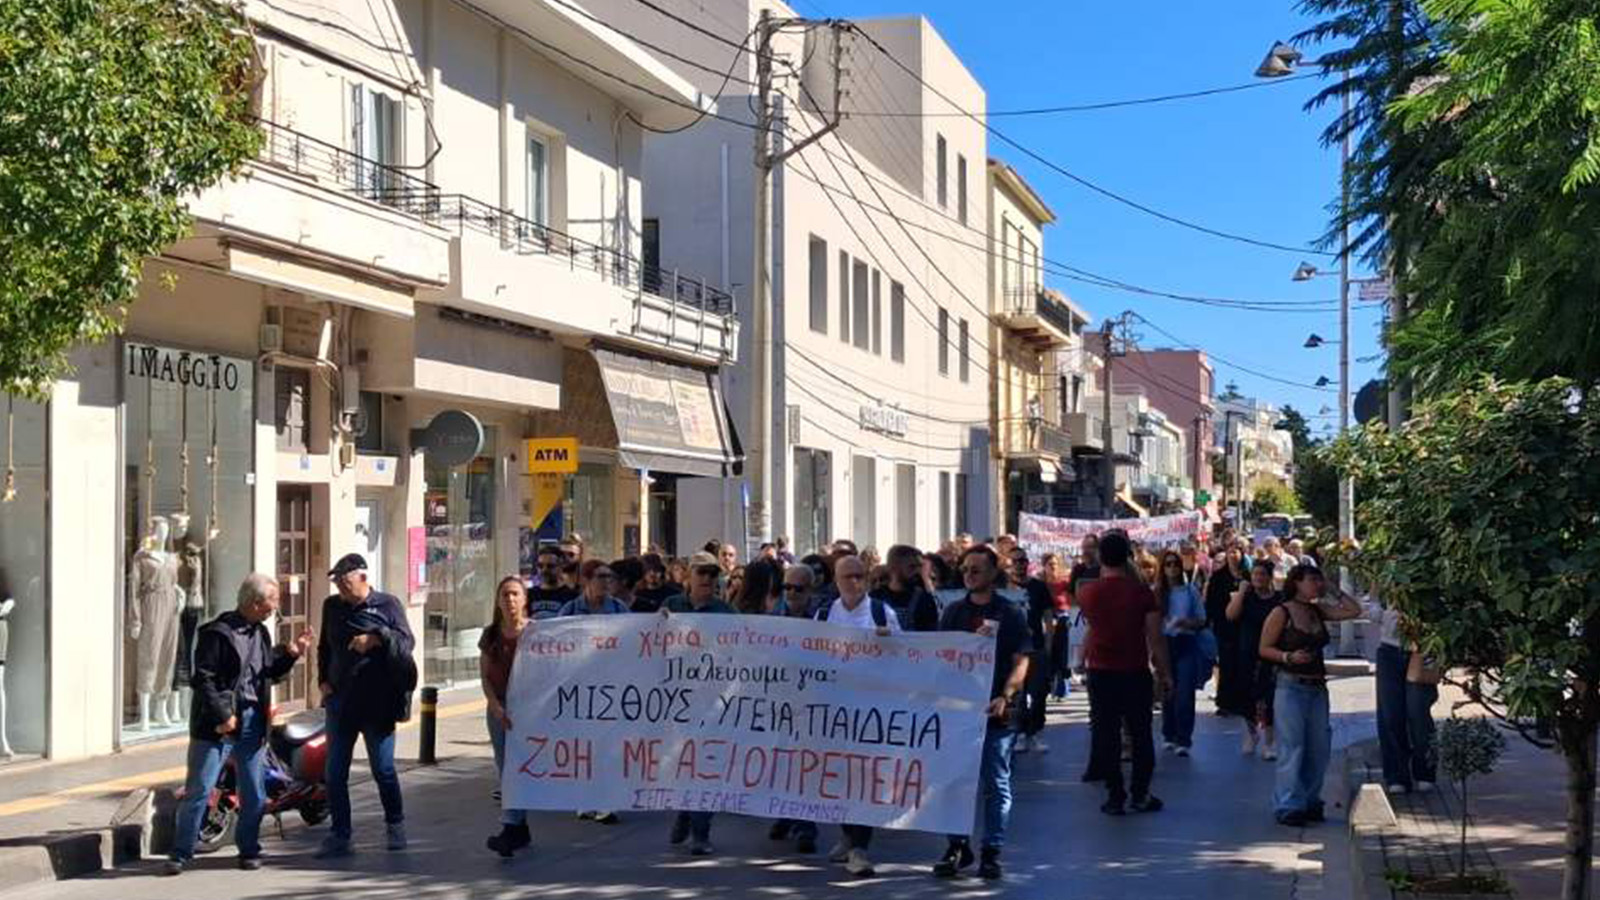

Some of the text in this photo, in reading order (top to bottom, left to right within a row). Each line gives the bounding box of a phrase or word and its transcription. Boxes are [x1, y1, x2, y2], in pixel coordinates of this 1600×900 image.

[128, 345, 238, 391] IMAGGIO
[534, 448, 569, 462] ATM
[591, 635, 621, 651] τα
[552, 684, 706, 728] ΜΙΣΘΟΥΣ,
[806, 703, 942, 750] ΠΑΙΔΕΙΑ
[518, 736, 923, 810] ΖΩΗ ΜΕ ΑΞΙΟΠΡΕΠΕΙΑ
